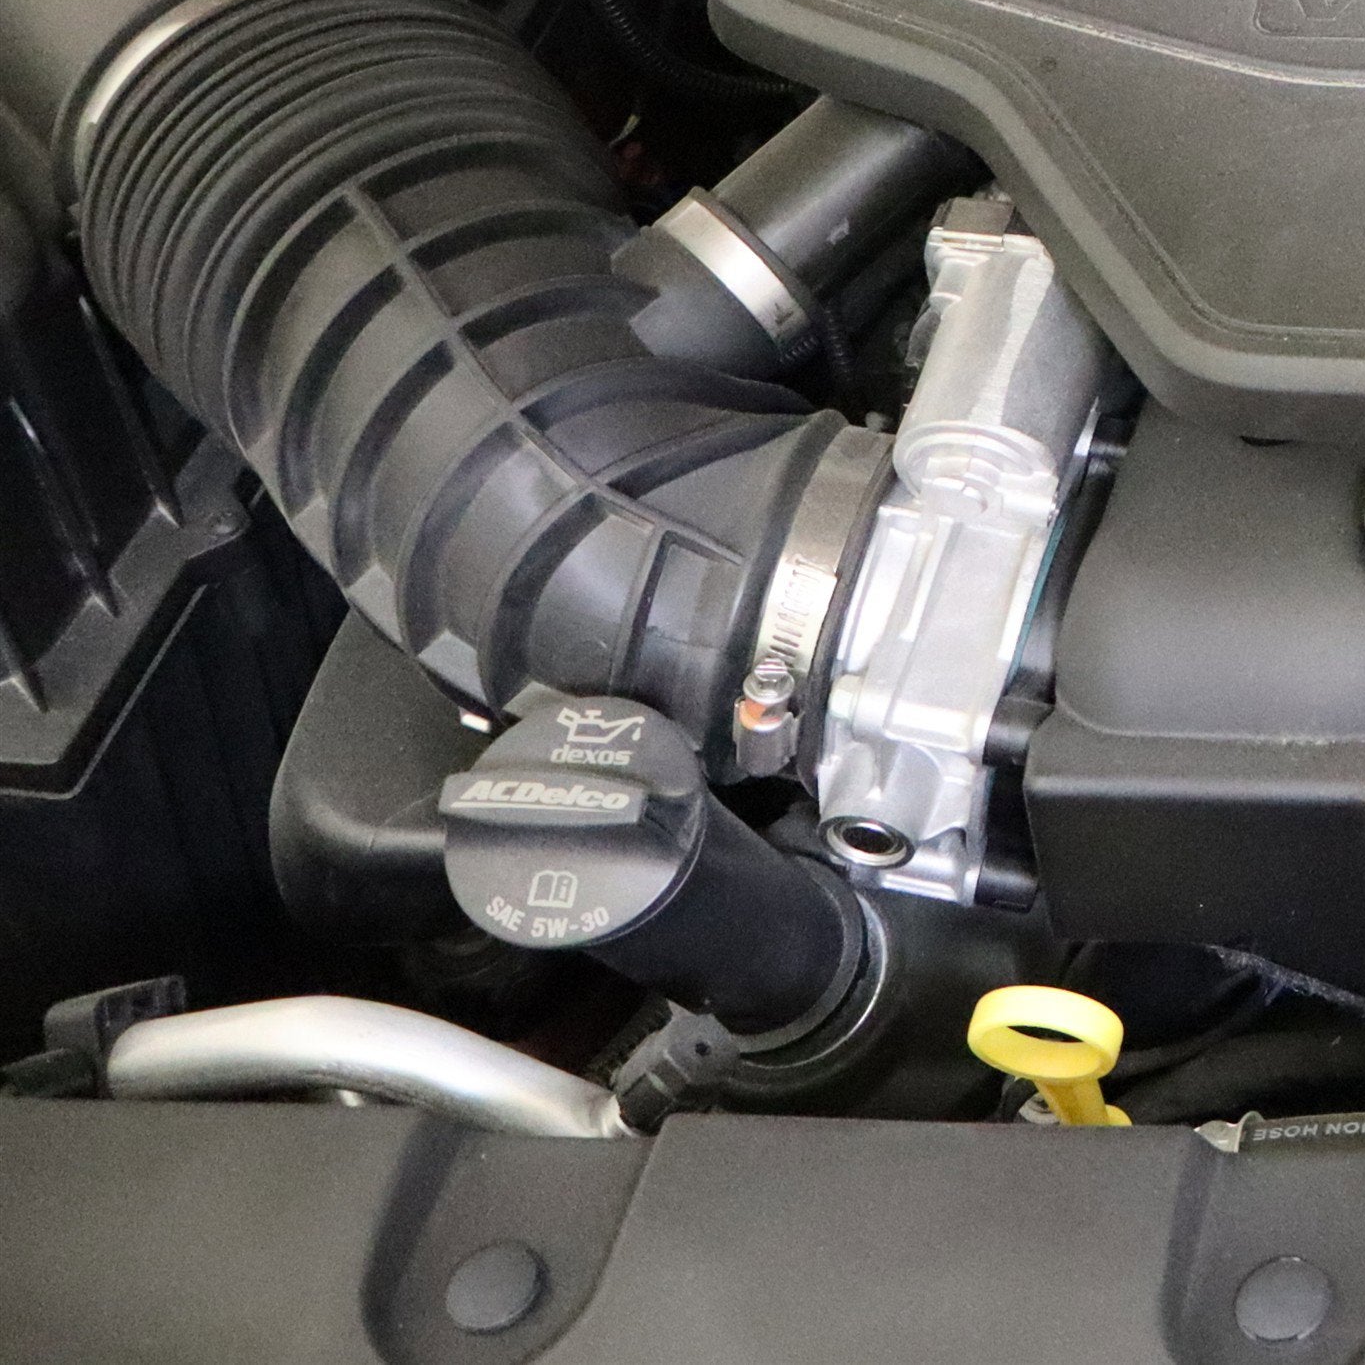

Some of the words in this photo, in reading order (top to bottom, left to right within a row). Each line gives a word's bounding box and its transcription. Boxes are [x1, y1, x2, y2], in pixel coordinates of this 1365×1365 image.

[550, 744, 635, 766] dexos
[459, 779, 631, 811] ACDelco
[485, 896, 526, 931] SAE
[531, 906, 610, 939] 5W-30
[1251, 1122, 1318, 1141] HOSE
